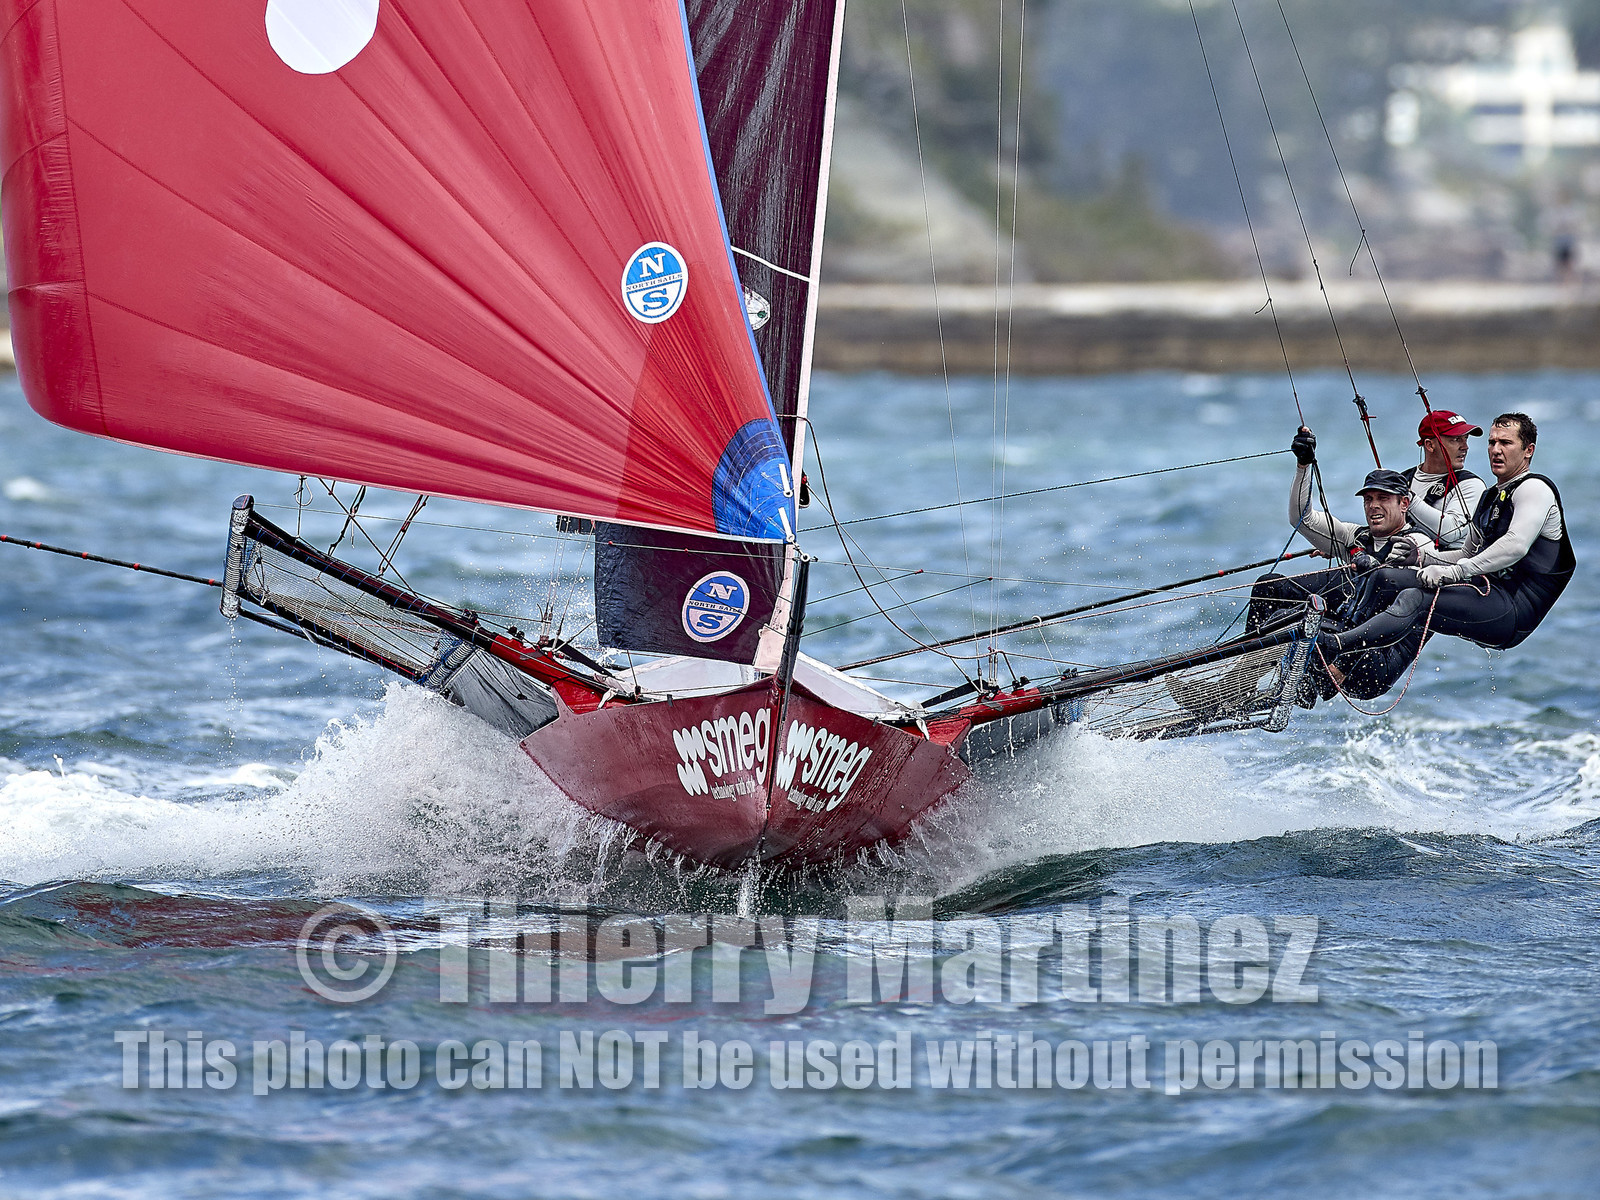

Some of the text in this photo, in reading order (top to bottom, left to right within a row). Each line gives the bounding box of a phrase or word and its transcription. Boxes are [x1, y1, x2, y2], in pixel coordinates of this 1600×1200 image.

[638, 252, 666, 279] N
[626, 274, 683, 291] NORTH SAILS
[642, 288, 669, 312] S
[706, 582, 738, 600] N
[688, 600, 716, 609] NORTH
[697, 613, 723, 629] S
[701, 708, 771, 785] smeg
[802, 728, 873, 812] smeg
